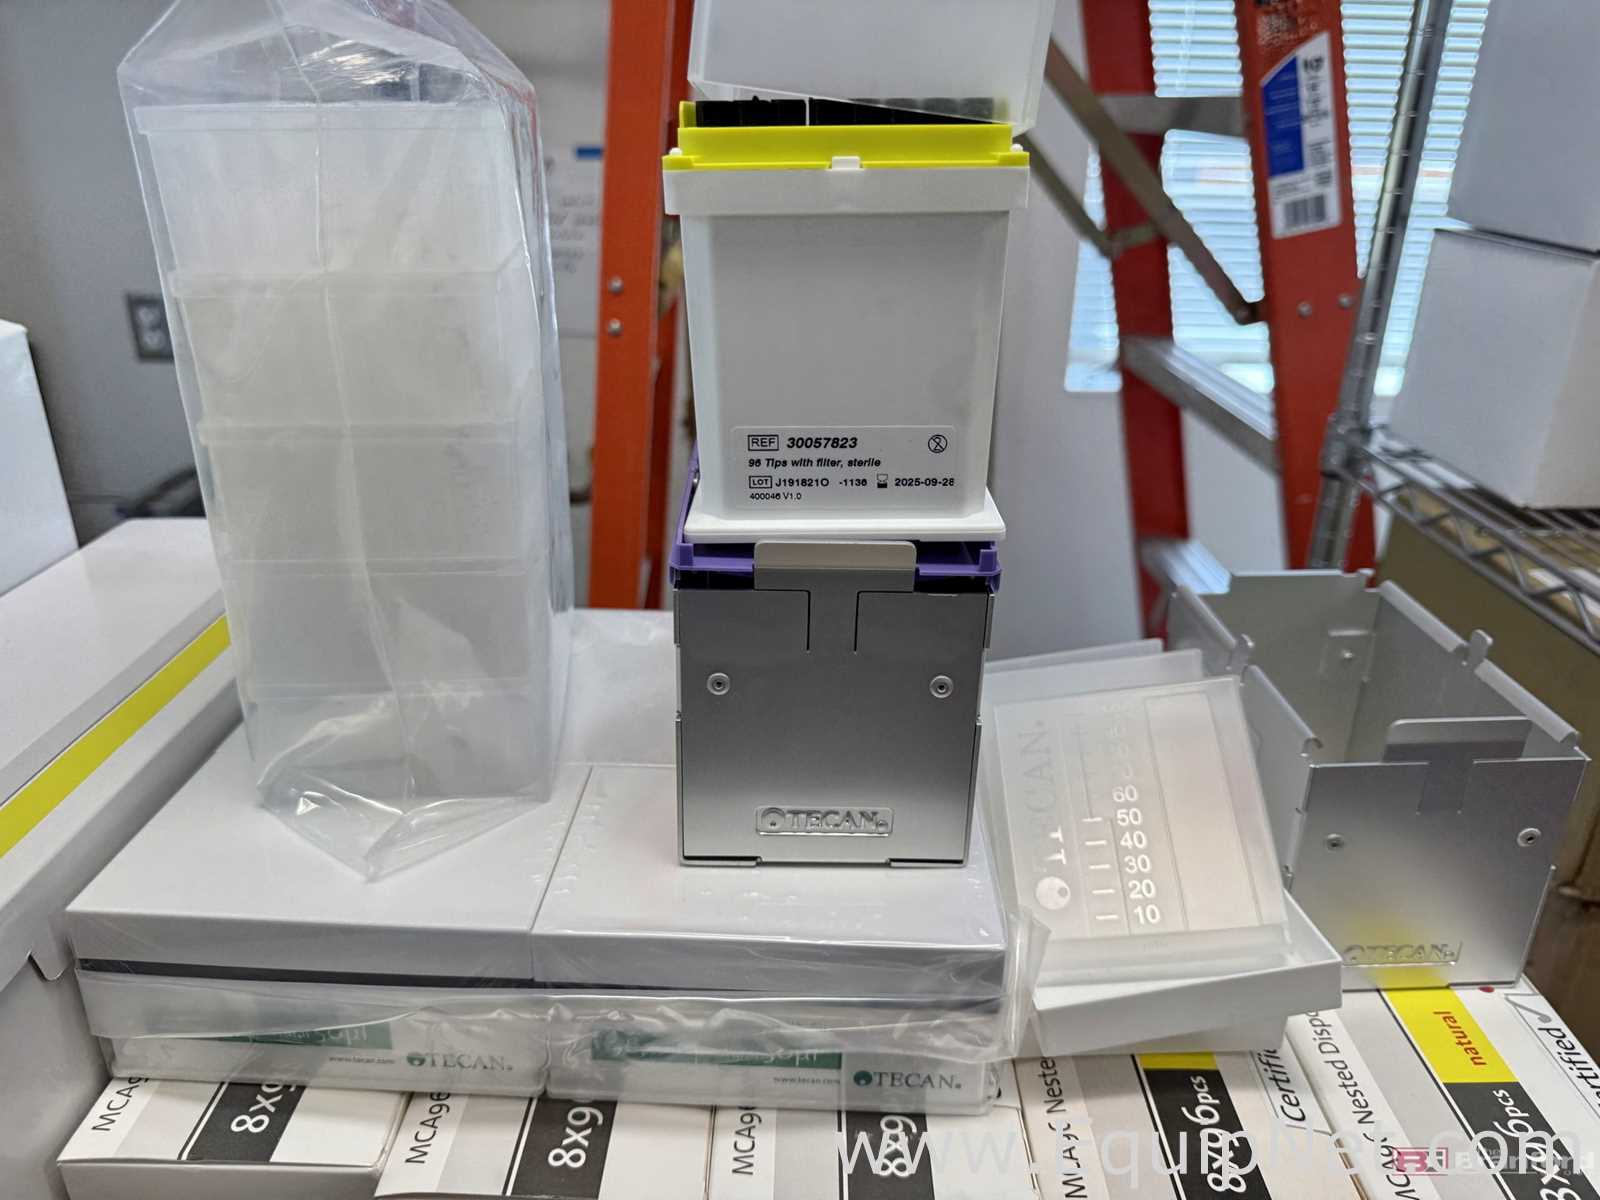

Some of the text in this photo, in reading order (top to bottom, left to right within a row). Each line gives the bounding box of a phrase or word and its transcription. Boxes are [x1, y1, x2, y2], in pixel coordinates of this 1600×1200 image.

[752, 437, 858, 448] REF 30057823
[765, 458, 788, 469] Tips
[791, 458, 813, 468] with
[816, 458, 844, 469] filter,
[847, 458, 882, 468] sterile
[752, 478, 769, 486] LOT
[1112, 785, 1139, 803] 60
[787, 809, 878, 829] TECAN
[1116, 807, 1143, 826] 50
[1120, 830, 1148, 849] 40
[1124, 854, 1152, 873] 30
[1128, 879, 1156, 898] 20
[1134, 904, 1161, 924] 10
[1367, 944, 1449, 961] TECAN
[1433, 1009, 1489, 1068] natural
[425, 1051, 504, 1071] TECAN
[871, 1071, 955, 1090] TECAN
[1040, 1055, 1067, 1115] Neste
[1333, 1060, 1375, 1125] Nested
